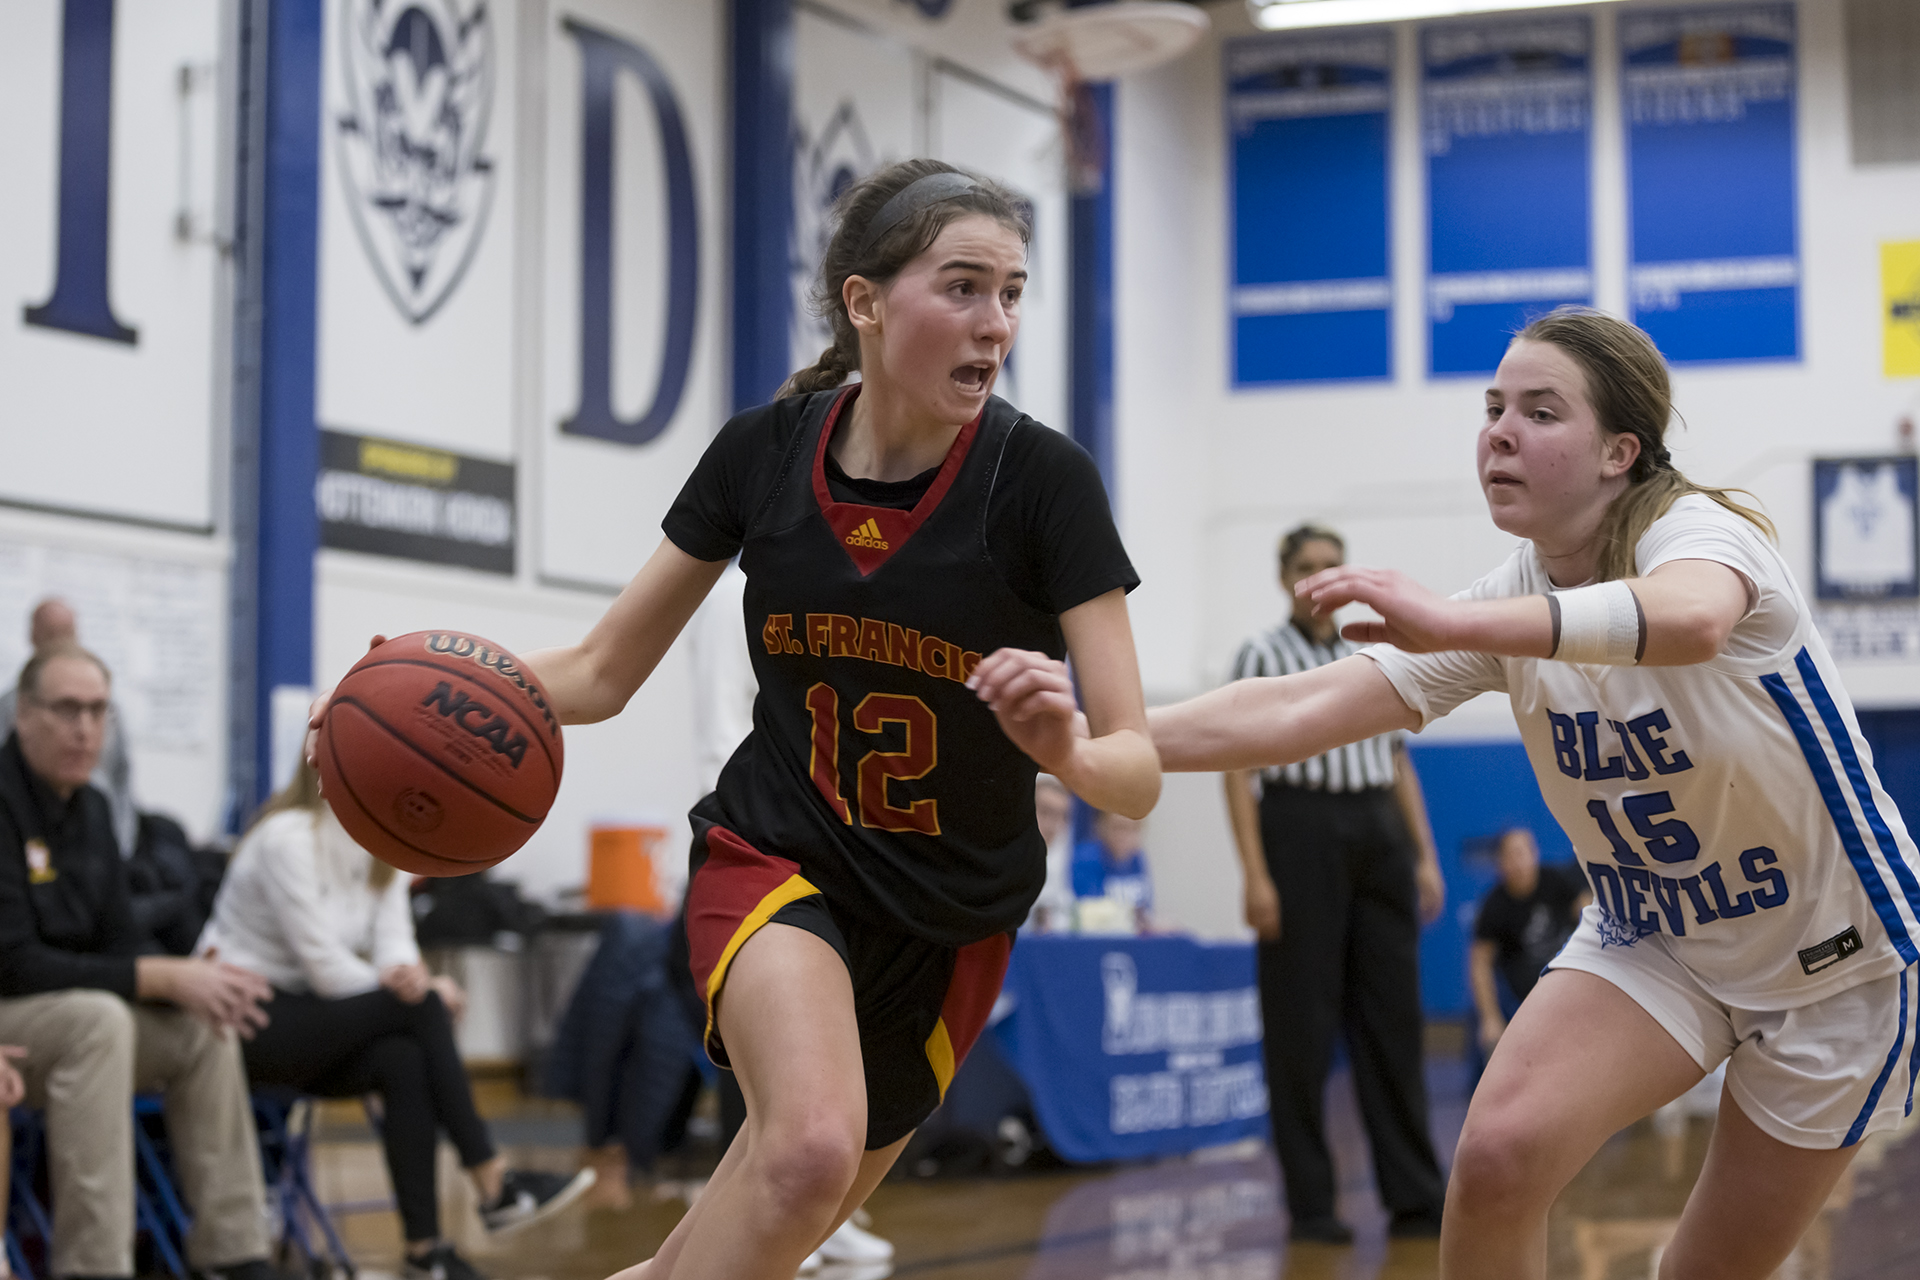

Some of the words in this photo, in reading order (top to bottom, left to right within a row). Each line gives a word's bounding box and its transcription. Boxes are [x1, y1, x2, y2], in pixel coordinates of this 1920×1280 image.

[558, 15, 702, 447] D
[845, 534, 889, 551] adidas
[763, 613, 804, 655] ST.
[422, 681, 529, 769] NCAA
[805, 681, 942, 836] 12
[1545, 708, 1694, 782] BLUE
[1586, 791, 1700, 866] 15
[1587, 846, 1790, 937] DEVILS
[1842, 938, 1855, 952] M
